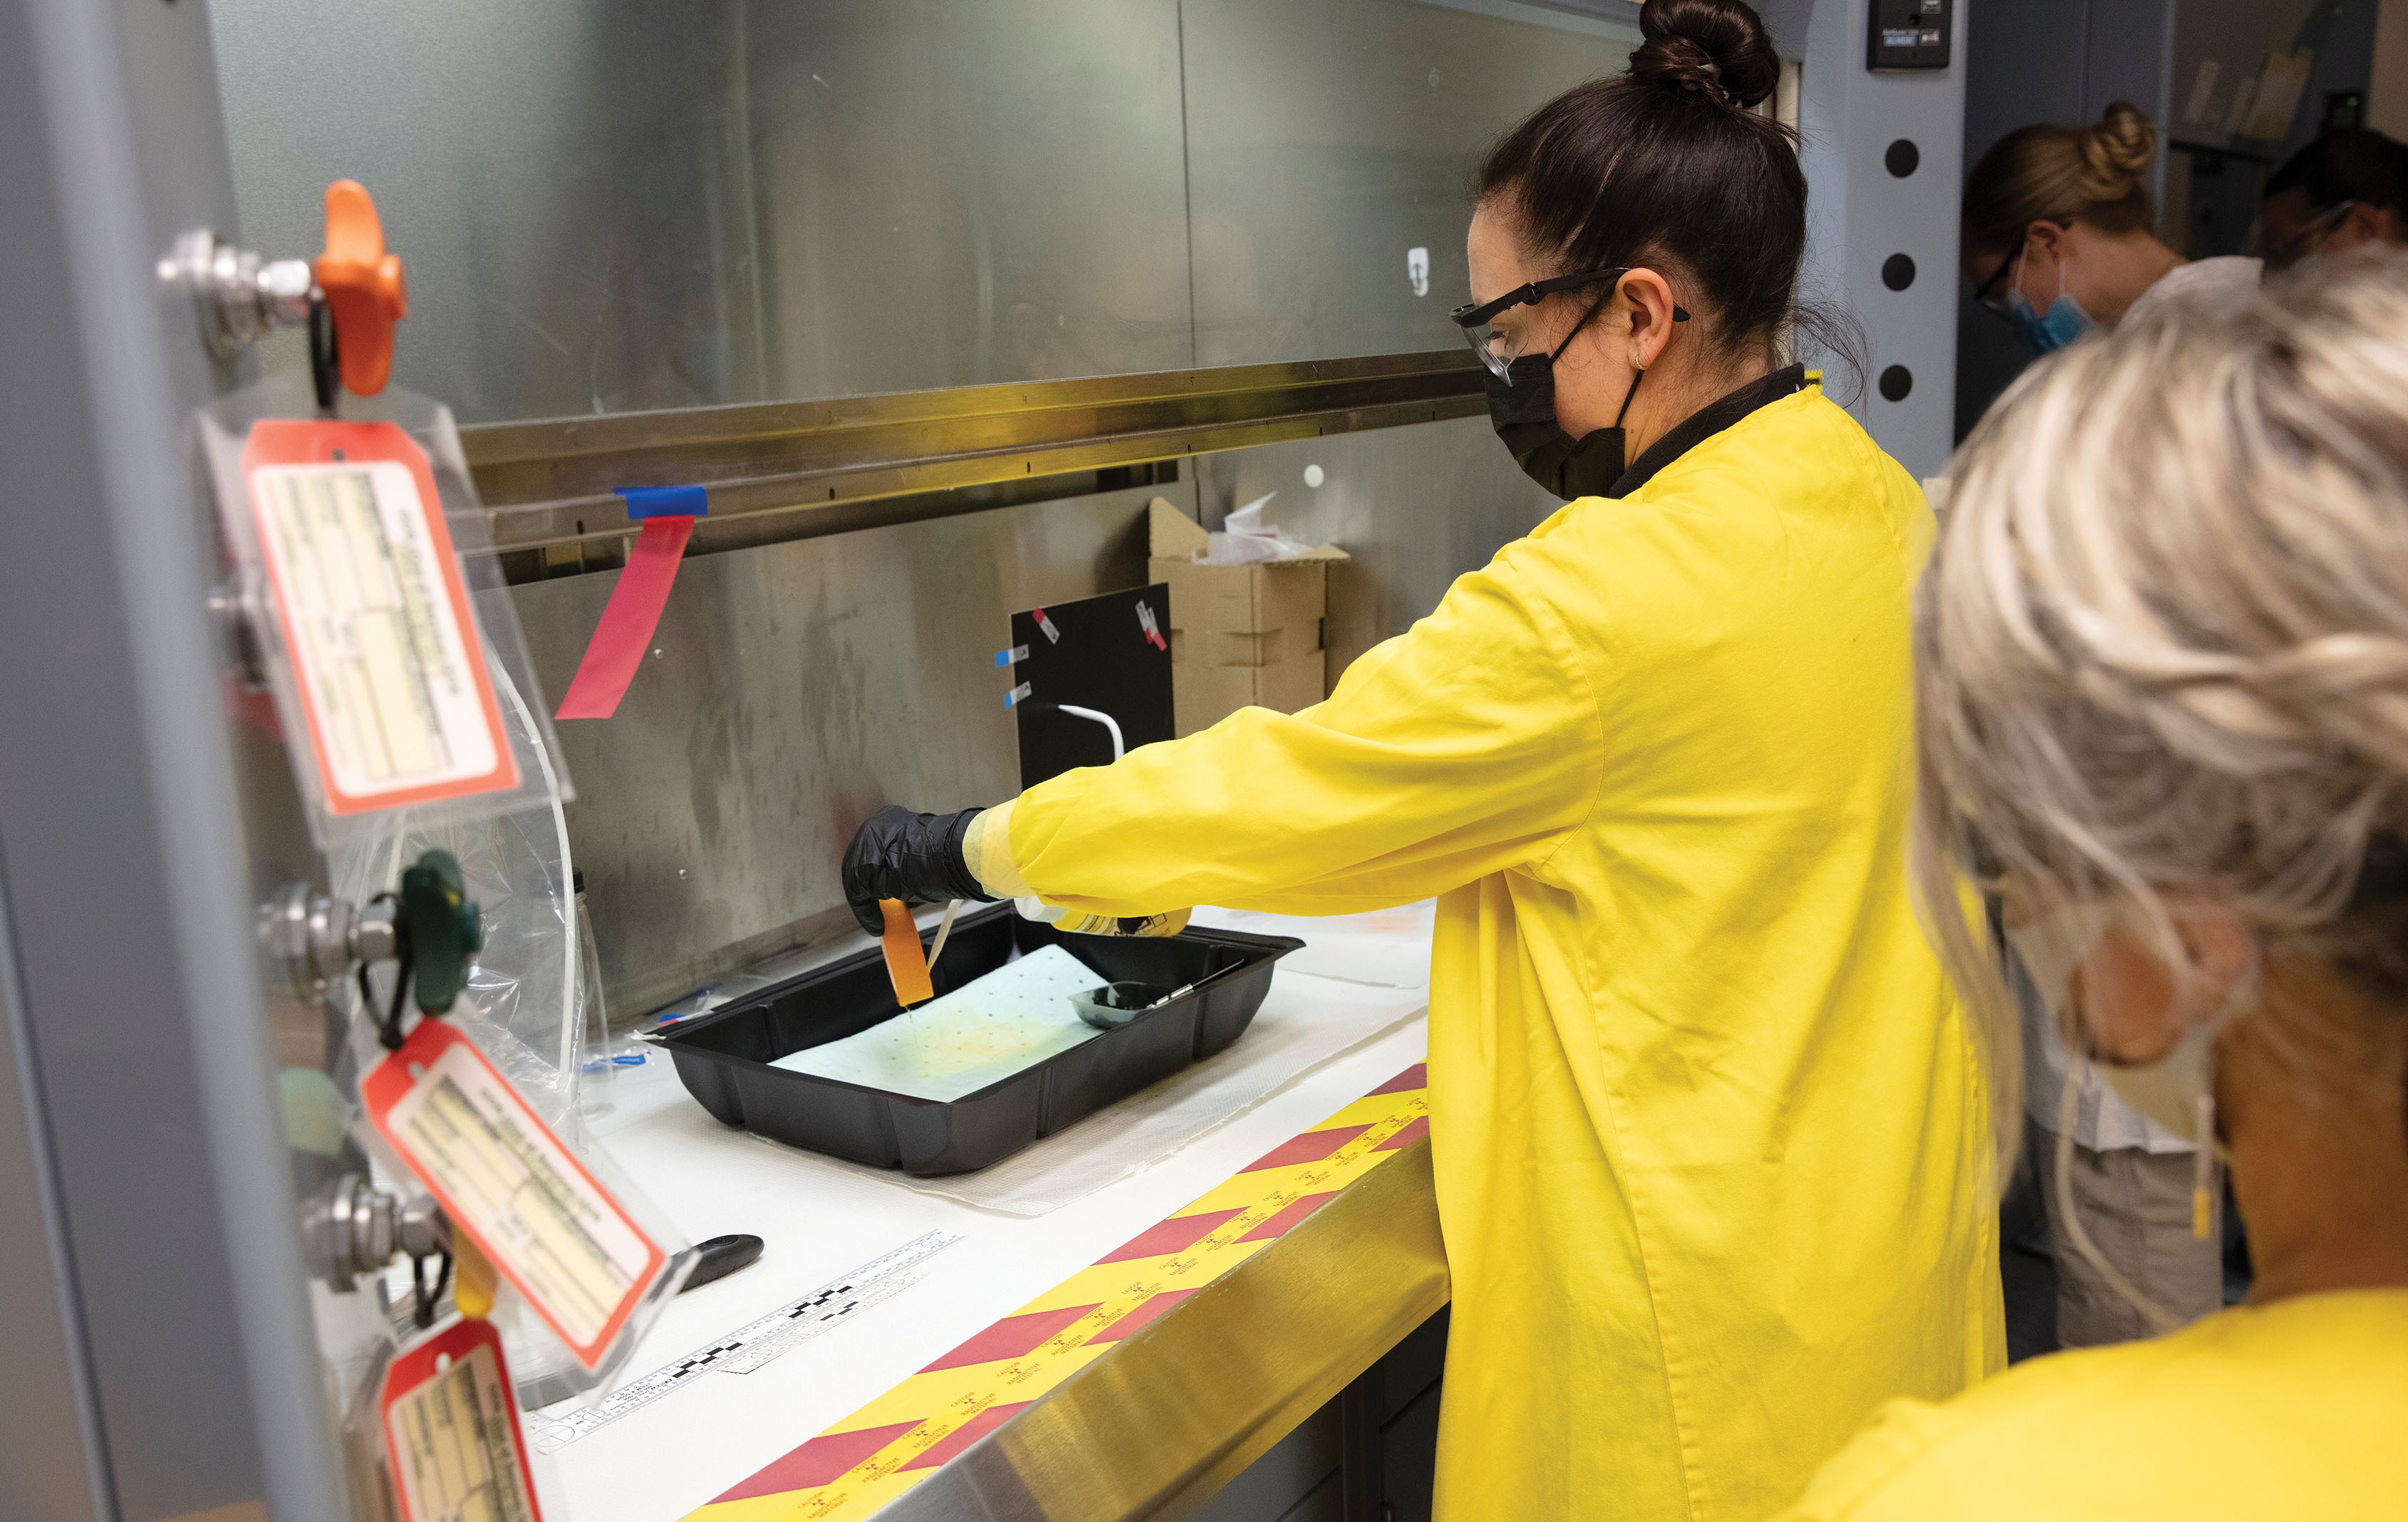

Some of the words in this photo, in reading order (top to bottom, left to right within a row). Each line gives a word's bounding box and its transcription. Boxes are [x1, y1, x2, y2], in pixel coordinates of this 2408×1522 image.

[1082, 1307, 1104, 1321] CAUTION
[1041, 1333, 1064, 1348] CAUTION
[997, 1362, 1020, 1377] CAUTION
[1007, 1362, 1041, 1385] RADIOACTIVE
[950, 1391, 975, 1407] CAUTION
[960, 1392, 997, 1416] RADIOACTIVE
[902, 1422, 927, 1440] CAUTION
[912, 1424, 949, 1449] RADIOACTIVE
[851, 1456, 878, 1474] CAUTION
[797, 1491, 825, 1509] CAUTION
